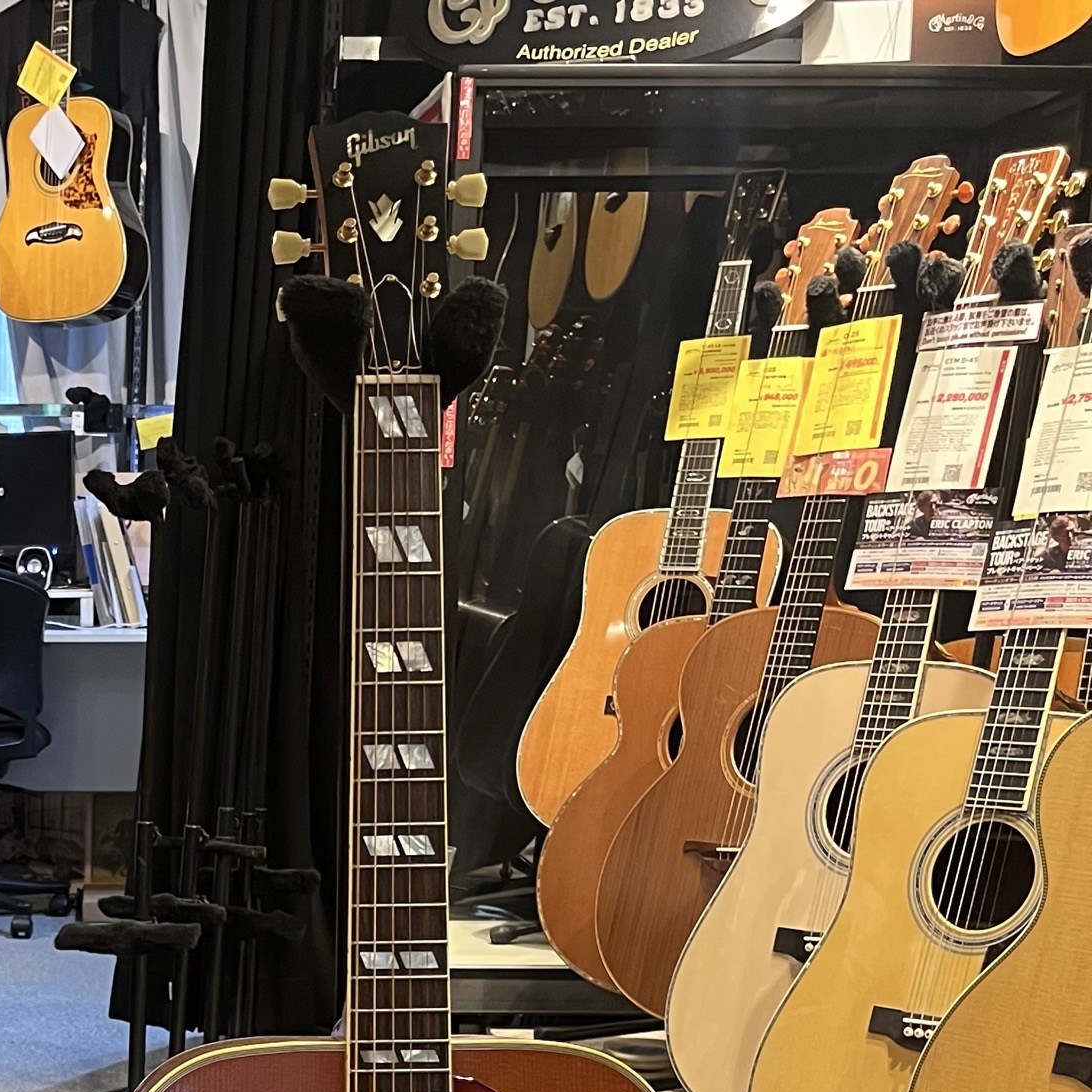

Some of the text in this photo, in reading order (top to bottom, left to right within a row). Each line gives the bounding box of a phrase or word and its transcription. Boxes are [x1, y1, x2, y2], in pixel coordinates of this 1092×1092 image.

[523, 6, 599, 33] EST.
[614, 0, 705, 24] 1833
[516, 30, 700, 62] Authorized Dealer
[346, 127, 419, 168] Gibson
[866, 502, 917, 518] BACKSTAGE
[864, 518, 885, 533] TOUR
[930, 519, 994, 530] ERIC CLAPTON
[991, 530, 1050, 551] BACKSTAGE
[989, 550, 1014, 567] TOUR
[1067, 549, 1092, 560] ERIC
